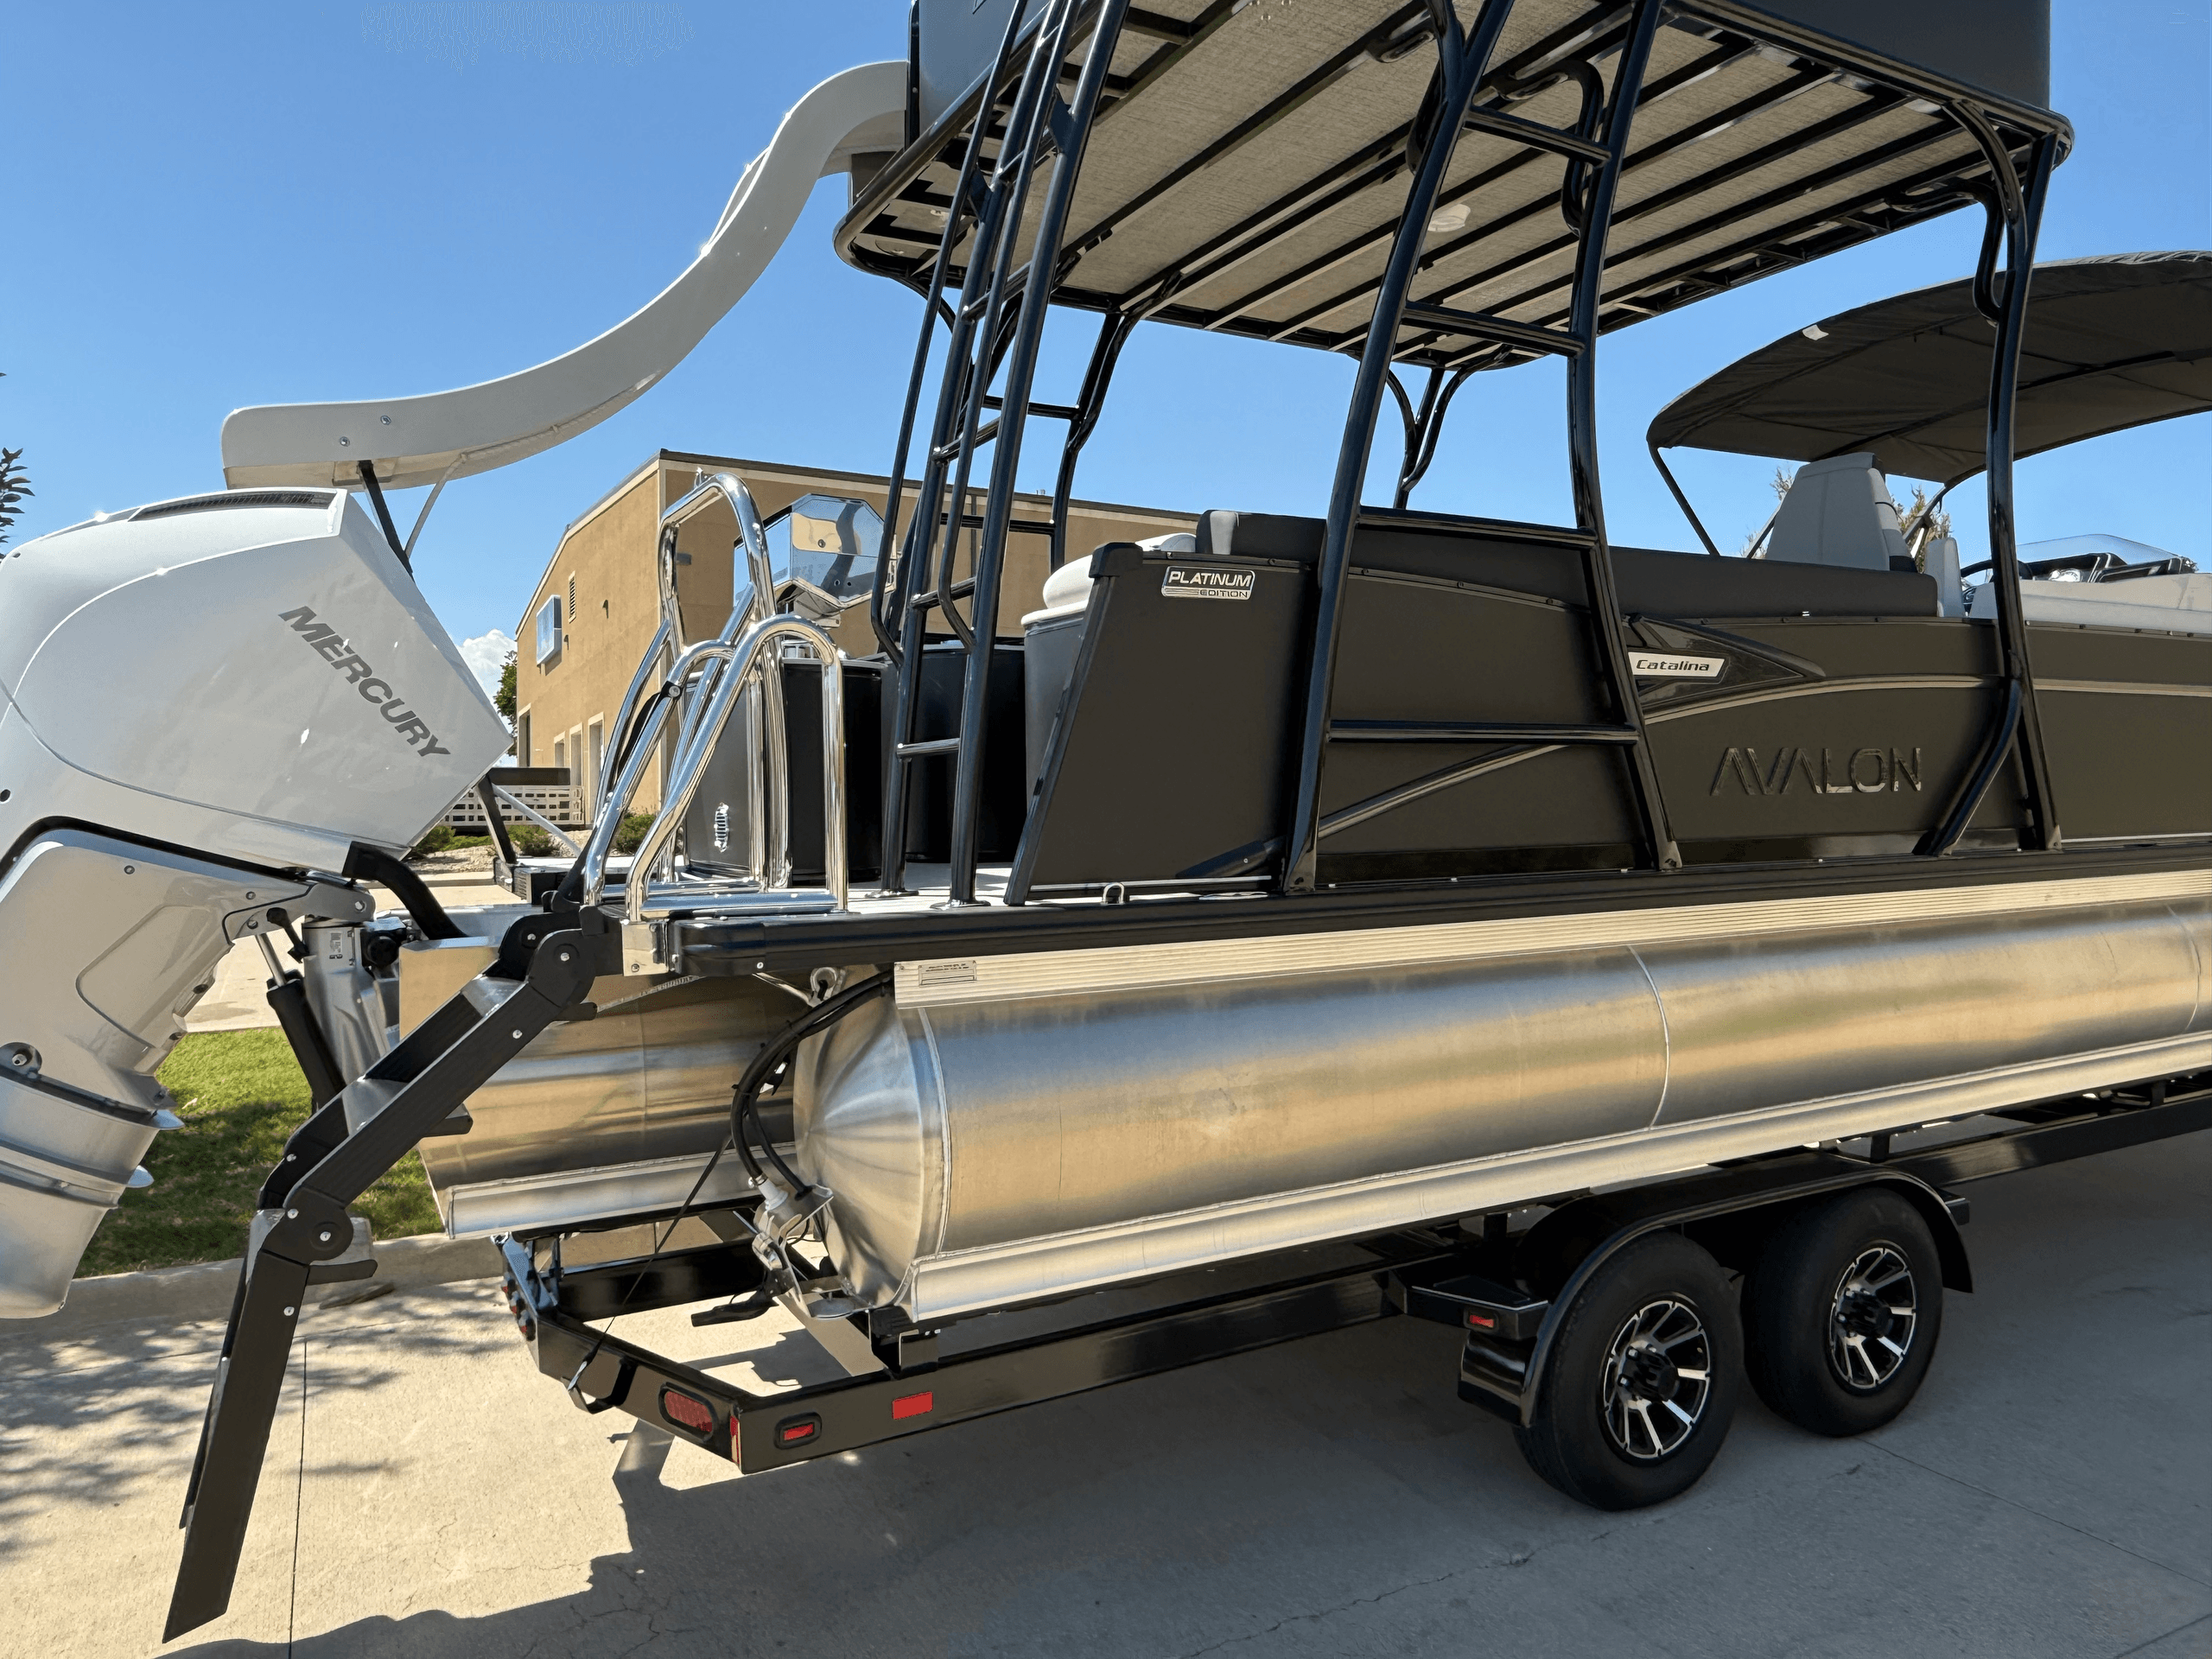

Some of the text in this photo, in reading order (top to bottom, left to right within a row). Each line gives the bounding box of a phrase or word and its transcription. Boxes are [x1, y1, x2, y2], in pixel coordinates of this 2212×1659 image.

[1168, 571, 1252, 587] PLATINUM
[1199, 589, 1248, 598] EDITION
[1636, 659, 1709, 671] Catalina
[278, 606, 450, 757] MERCURY
[1709, 747, 1922, 796] AVALON
